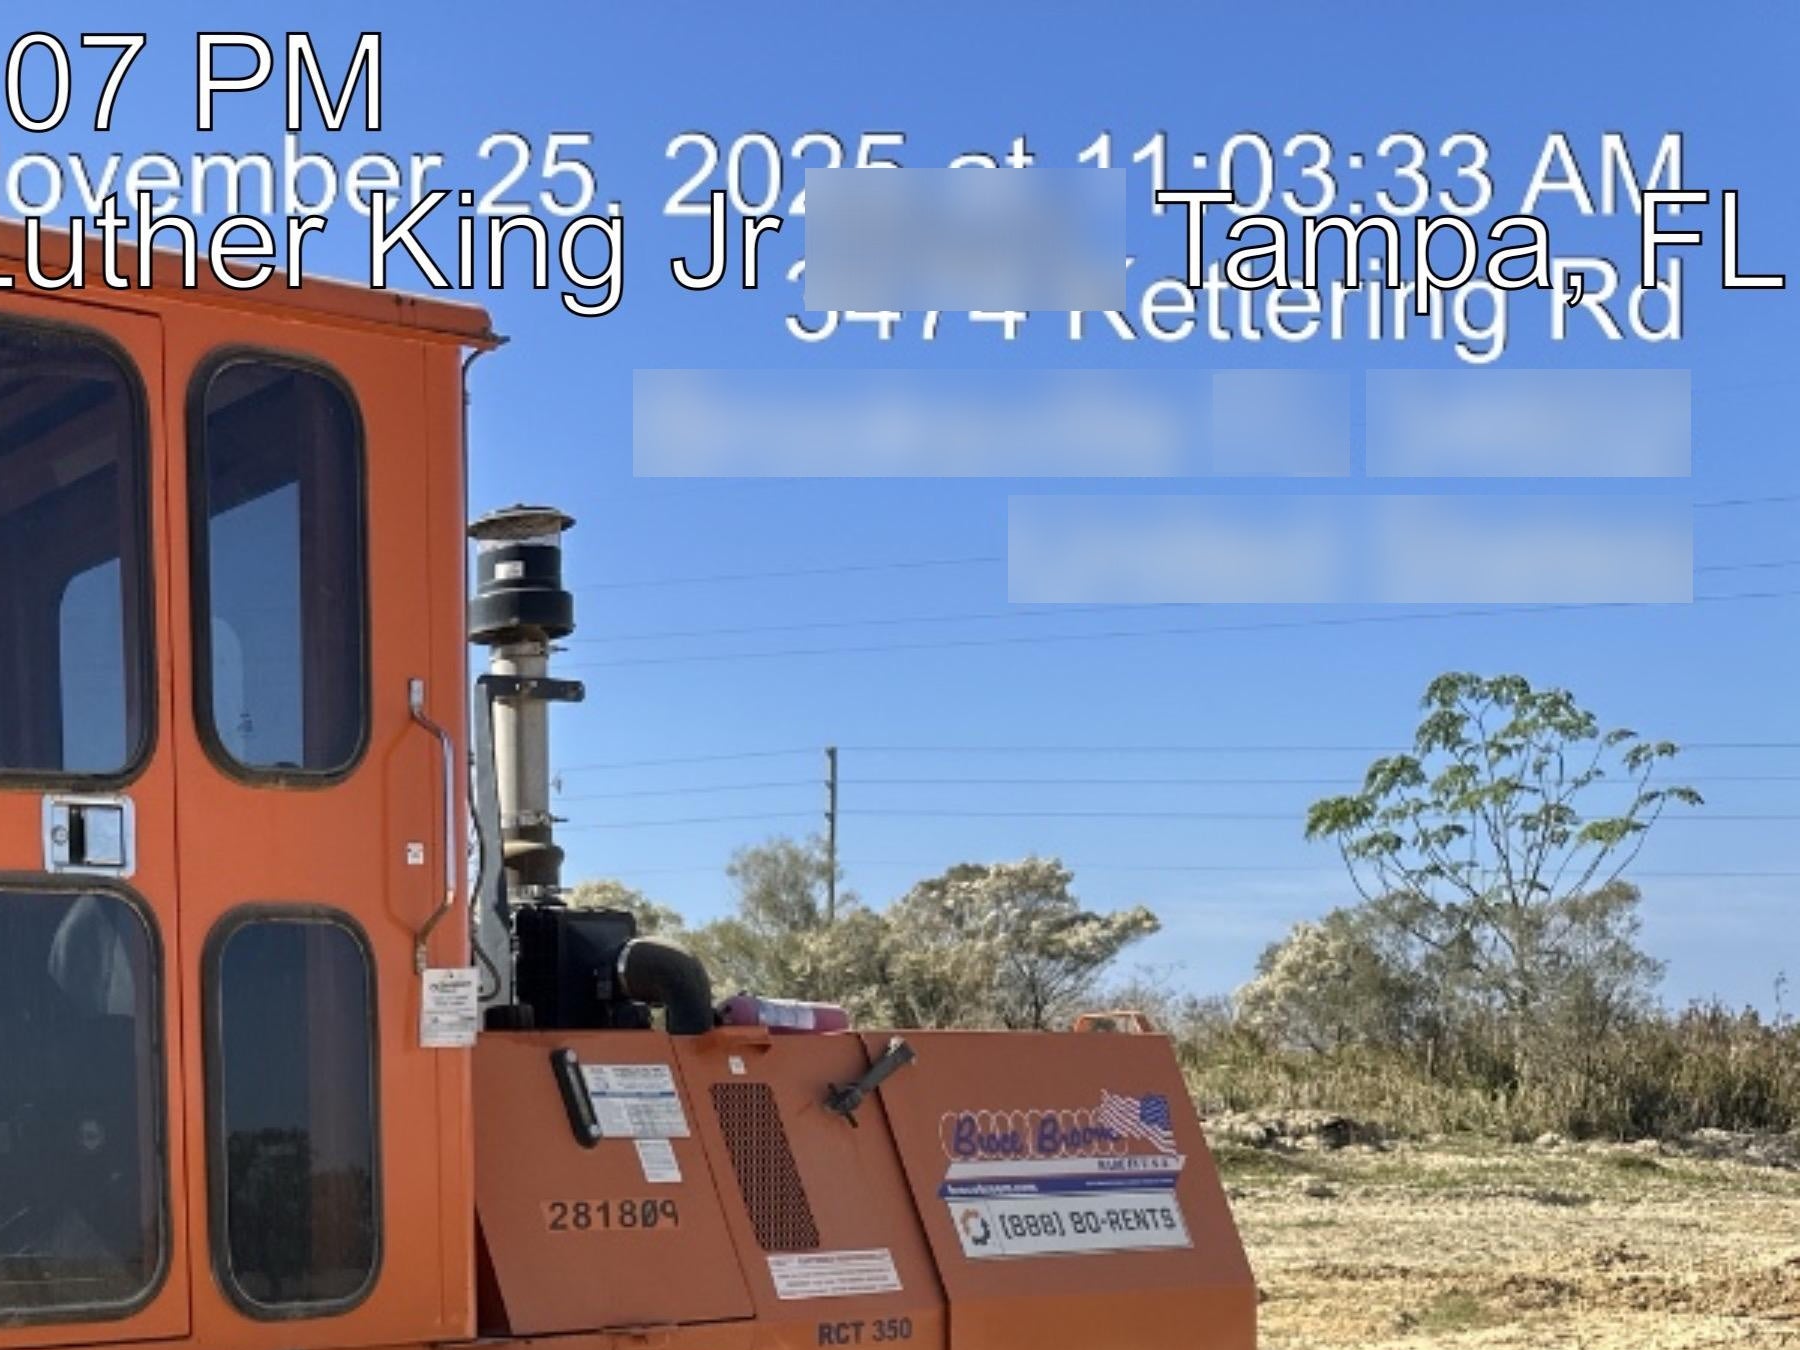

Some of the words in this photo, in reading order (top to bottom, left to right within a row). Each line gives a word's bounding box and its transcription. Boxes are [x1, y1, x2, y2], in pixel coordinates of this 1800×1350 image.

[549, 1199, 679, 1231] 281809
[817, 1319, 864, 1348] RCT
[872, 1316, 913, 1342] 350
